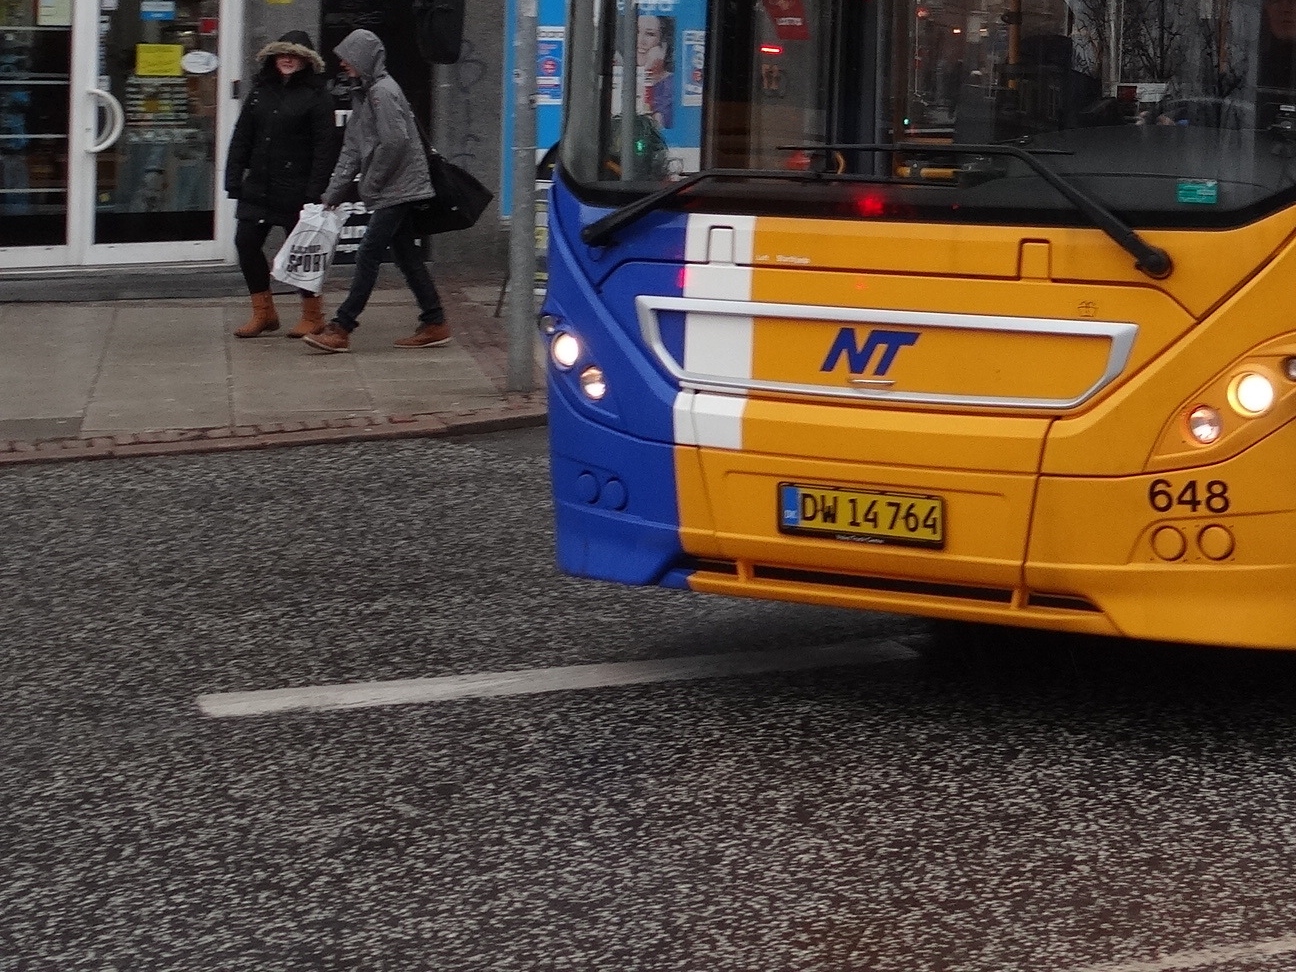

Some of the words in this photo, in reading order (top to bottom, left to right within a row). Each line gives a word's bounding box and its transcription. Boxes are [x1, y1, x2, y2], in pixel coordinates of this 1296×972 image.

[287, 253, 328, 274] SPORT
[820, 327, 921, 376] NT
[801, 493, 838, 524] DW
[1149, 478, 1230, 514] 648
